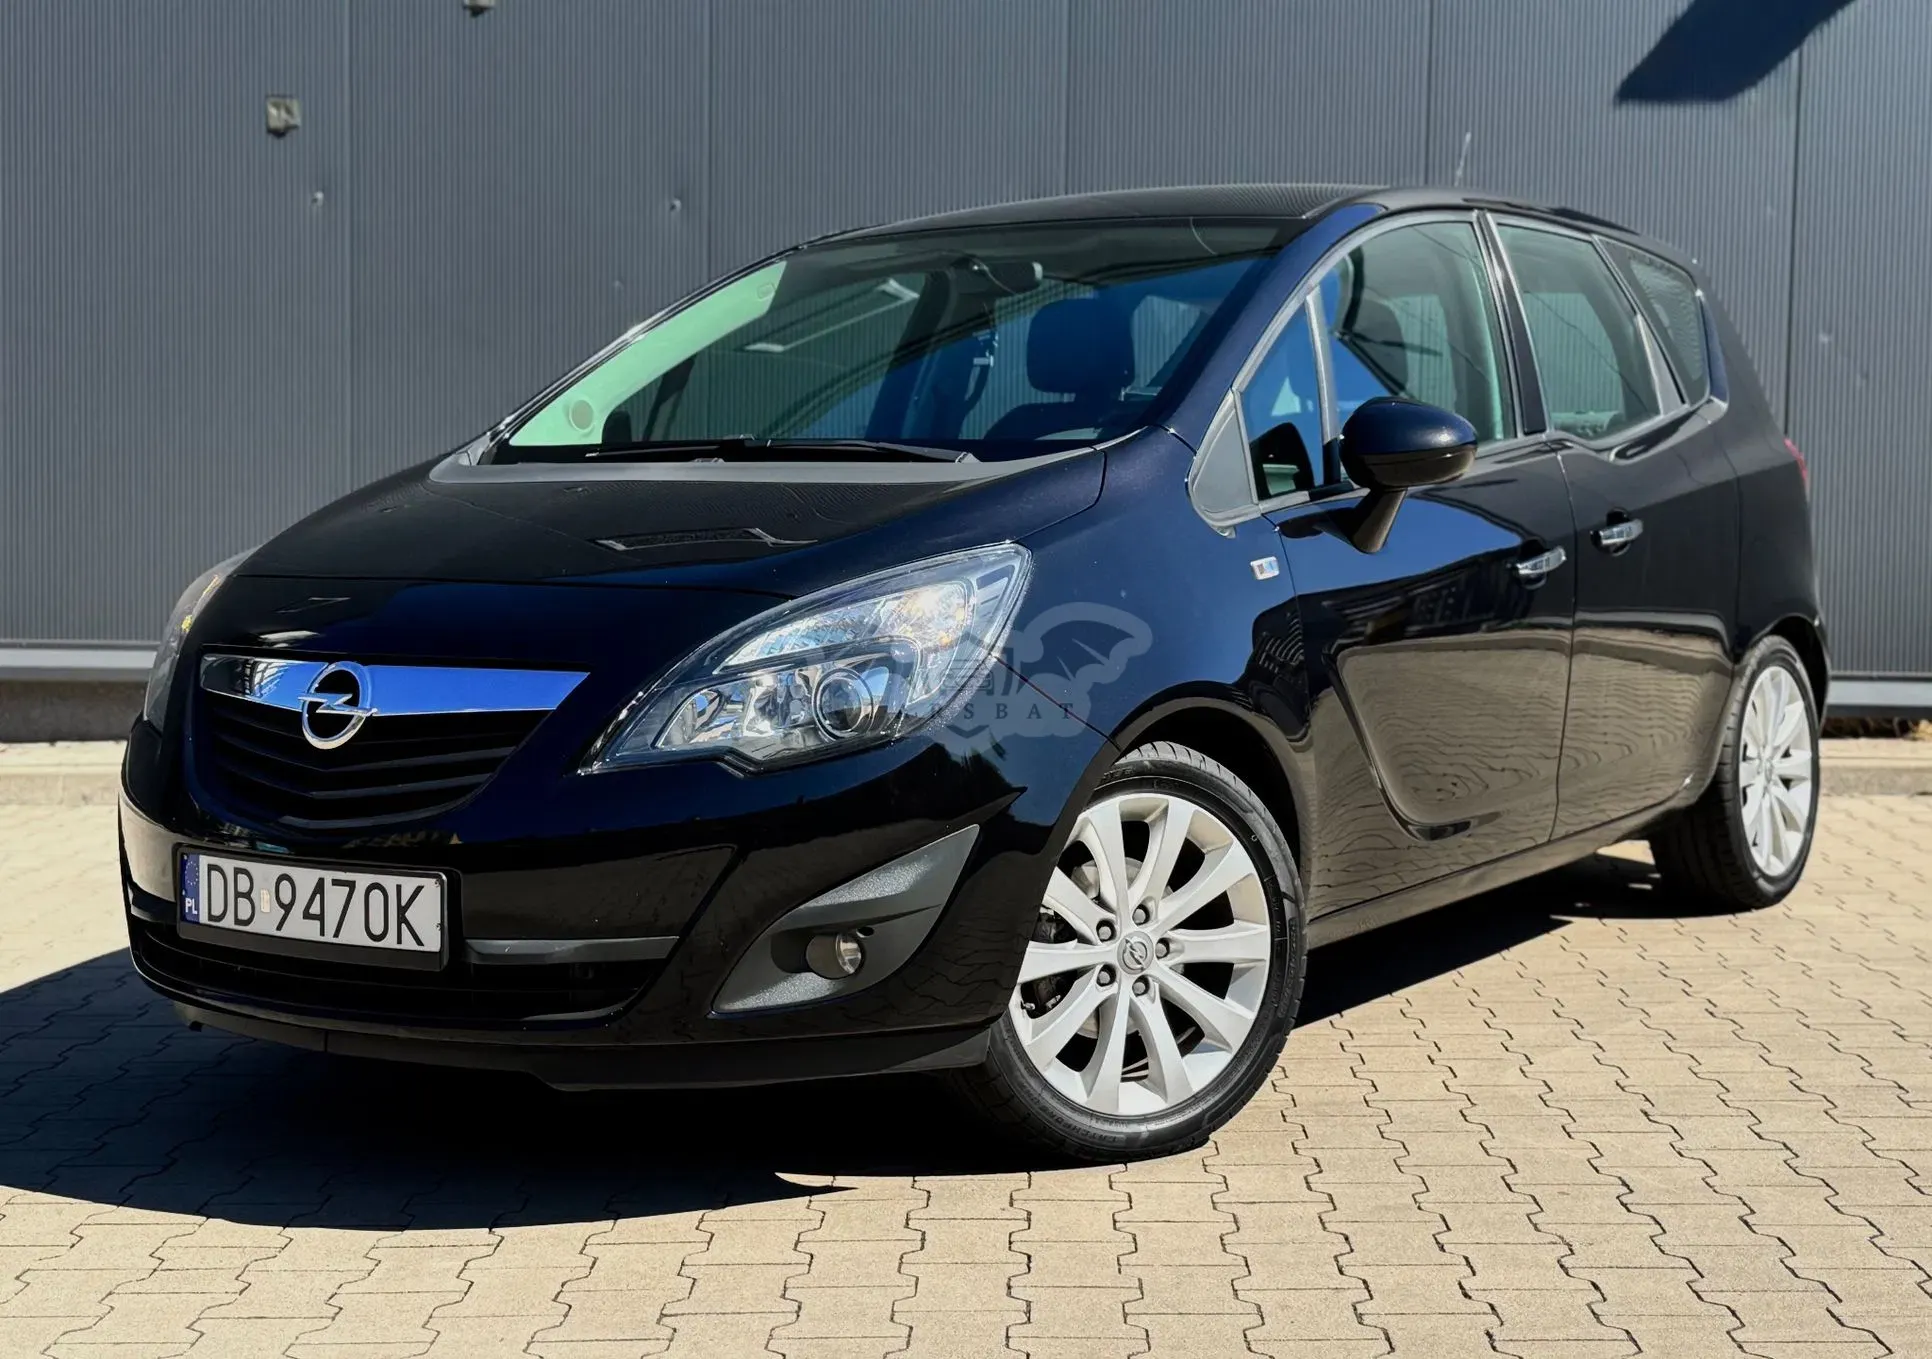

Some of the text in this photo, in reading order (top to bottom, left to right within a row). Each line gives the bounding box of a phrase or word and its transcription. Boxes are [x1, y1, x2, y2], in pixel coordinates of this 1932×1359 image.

[185, 897, 198, 915] PL
[207, 864, 424, 947] DB 9470K
